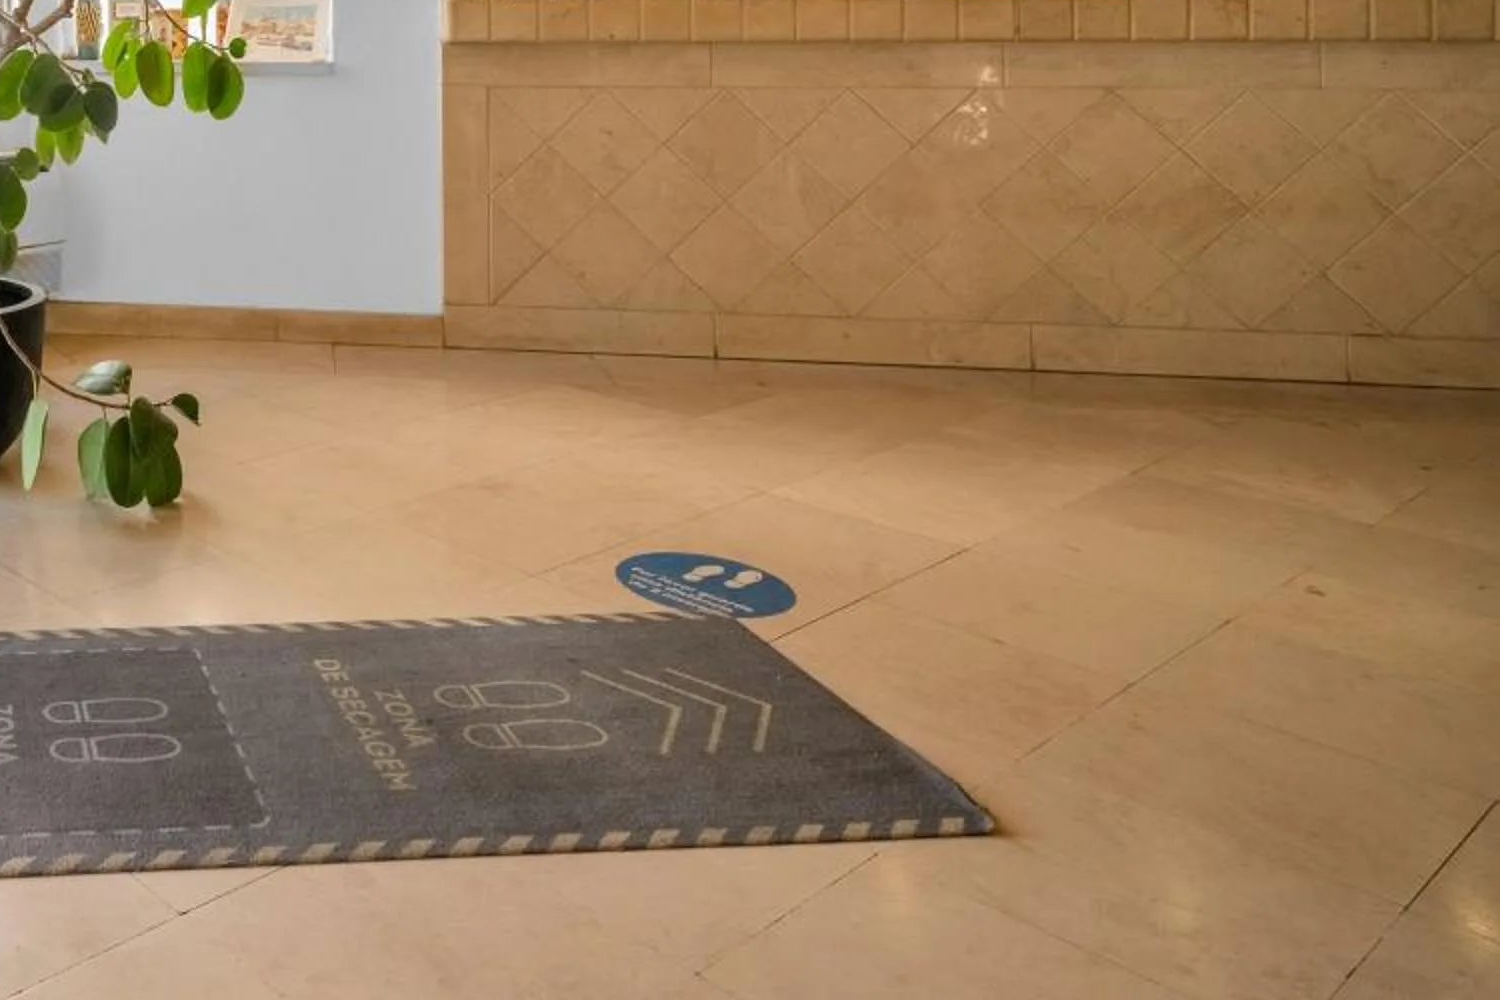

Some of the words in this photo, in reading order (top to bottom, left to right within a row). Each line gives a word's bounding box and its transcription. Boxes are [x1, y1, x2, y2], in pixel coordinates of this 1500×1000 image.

[313, 658, 350, 682] DE
[331, 686, 418, 791] SECAGEM
[373, 688, 436, 748] ZONA
